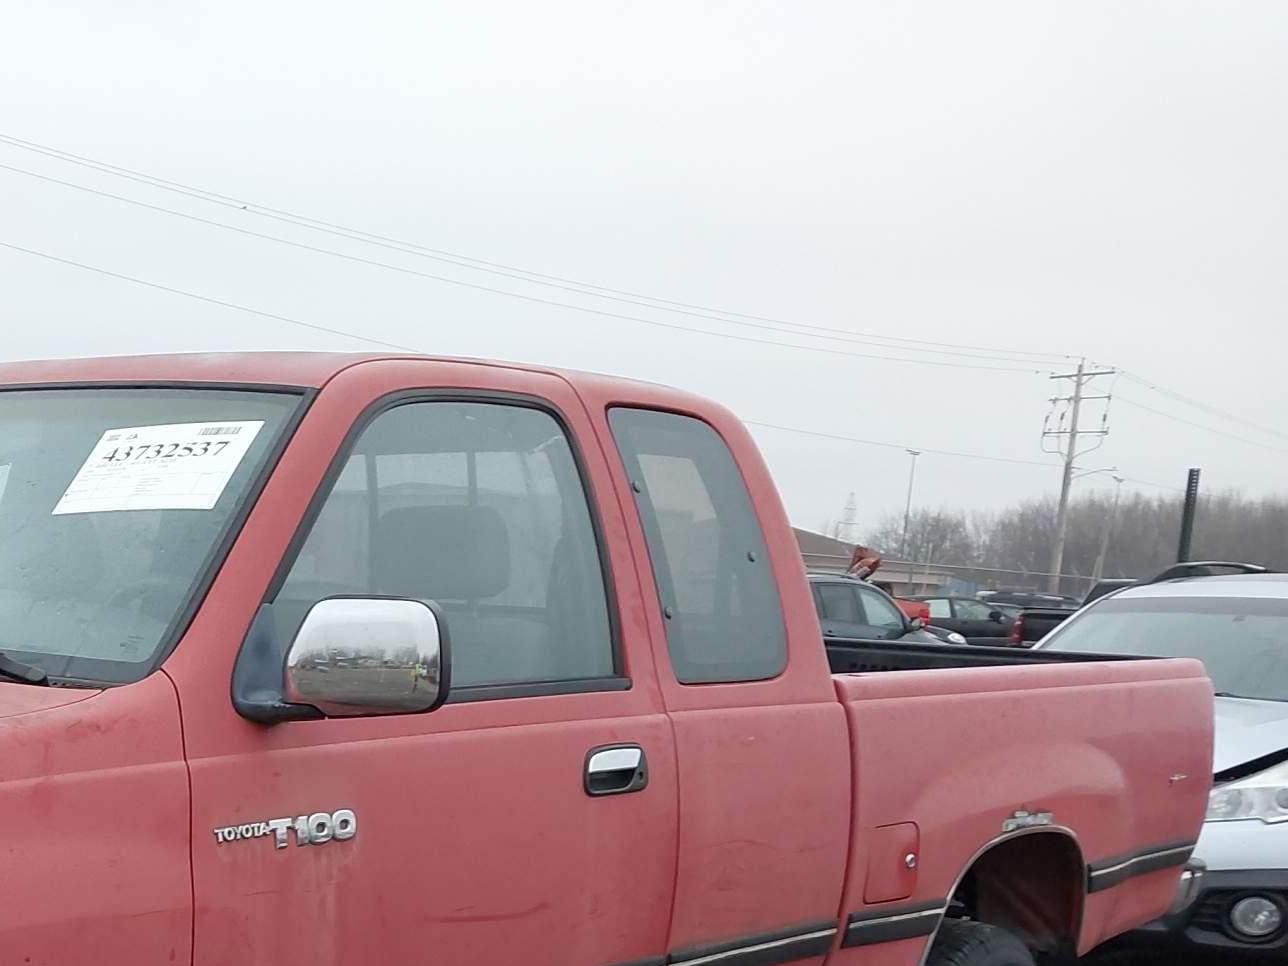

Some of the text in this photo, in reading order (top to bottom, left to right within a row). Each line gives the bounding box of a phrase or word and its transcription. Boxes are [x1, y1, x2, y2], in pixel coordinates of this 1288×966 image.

[103, 440, 231, 462] 43732537
[214, 809, 357, 849] TOYOTA T100
